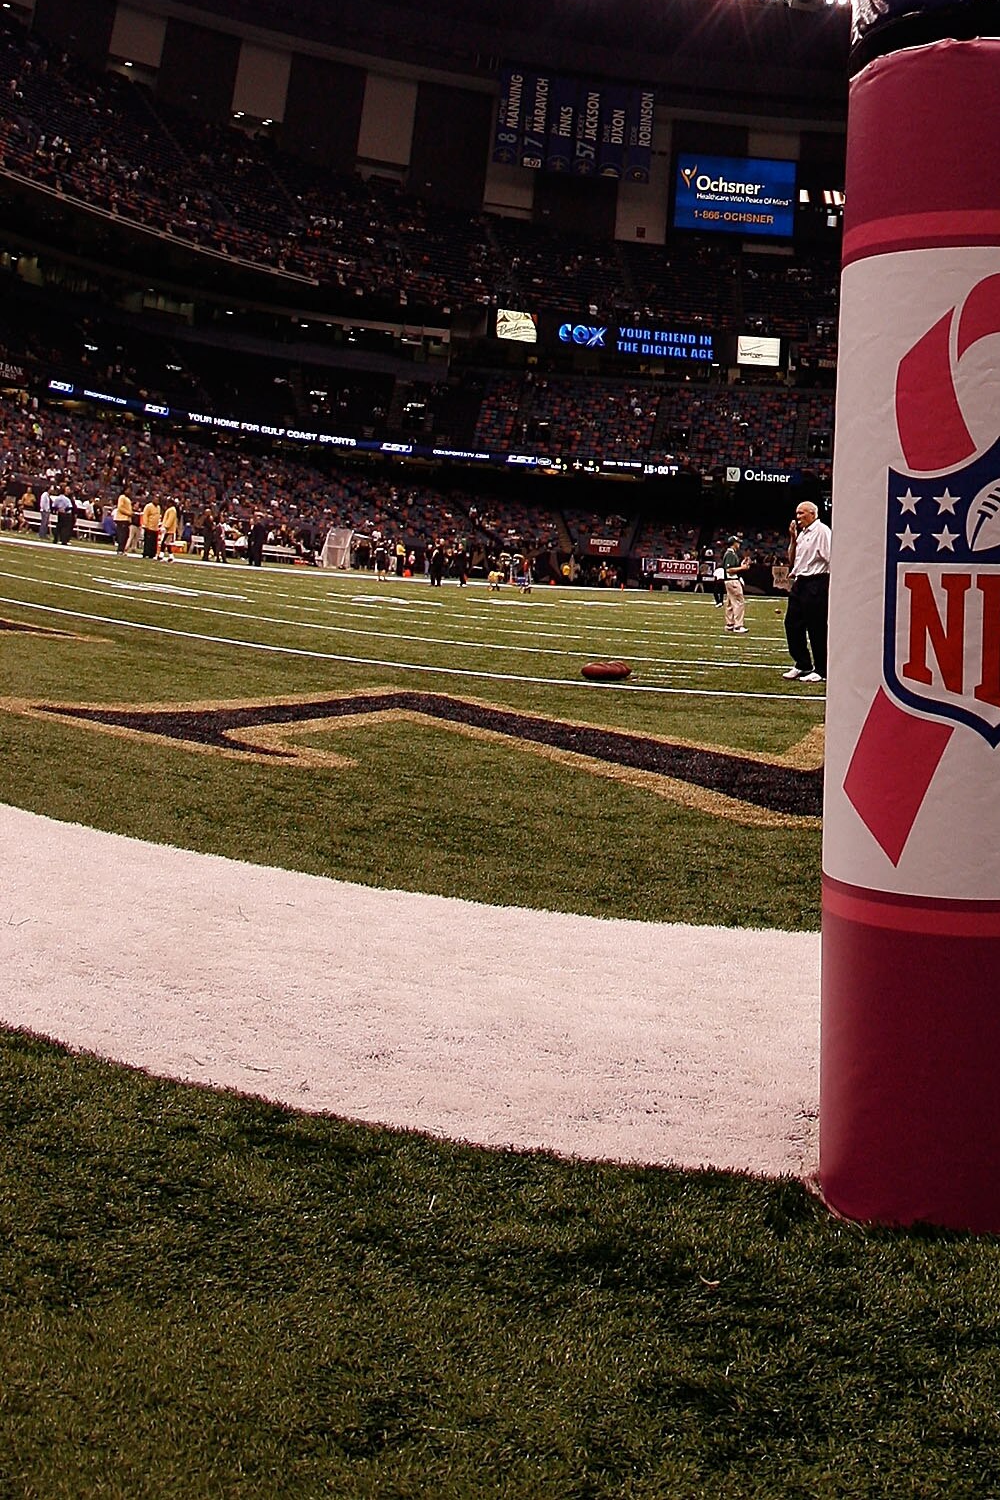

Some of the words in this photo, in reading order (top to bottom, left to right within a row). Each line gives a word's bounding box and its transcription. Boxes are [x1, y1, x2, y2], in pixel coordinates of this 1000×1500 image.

[506, 74, 524, 129] MANNING
[533, 77, 550, 134] MARAVICH
[559, 105, 574, 138] FINKS
[584, 91, 600, 141] JACKSON
[638, 92, 655, 147] ROBINSON
[610, 109, 626, 145] DIXON
[497, 132, 518, 144] 8
[523, 134, 543, 149] 7
[576, 140, 596, 160] 57
[696, 175, 761, 195] Ochsner
[697, 193, 730, 202] Healthcare
[745, 197, 763, 205] Peace
[558, 323, 608, 349] COX
[619, 326, 650, 340] YOUR
[654, 330, 696, 344] FRIEND
[700, 334, 712, 346] IN
[616, 340, 640, 354] THE
[641, 343, 687, 357] DIGITAL
[690, 348, 714, 360] AGE
[188, 412, 212, 424] YOUR
[213, 417, 240, 429] HOME
[241, 422, 259, 432] FOR
[261, 426, 285, 436] GULF
[287, 430, 318, 441] COAST
[319, 434, 356, 446] SPORTS
[643, 464, 669, 475] 15:00
[744, 470, 791, 483] Ochsner
